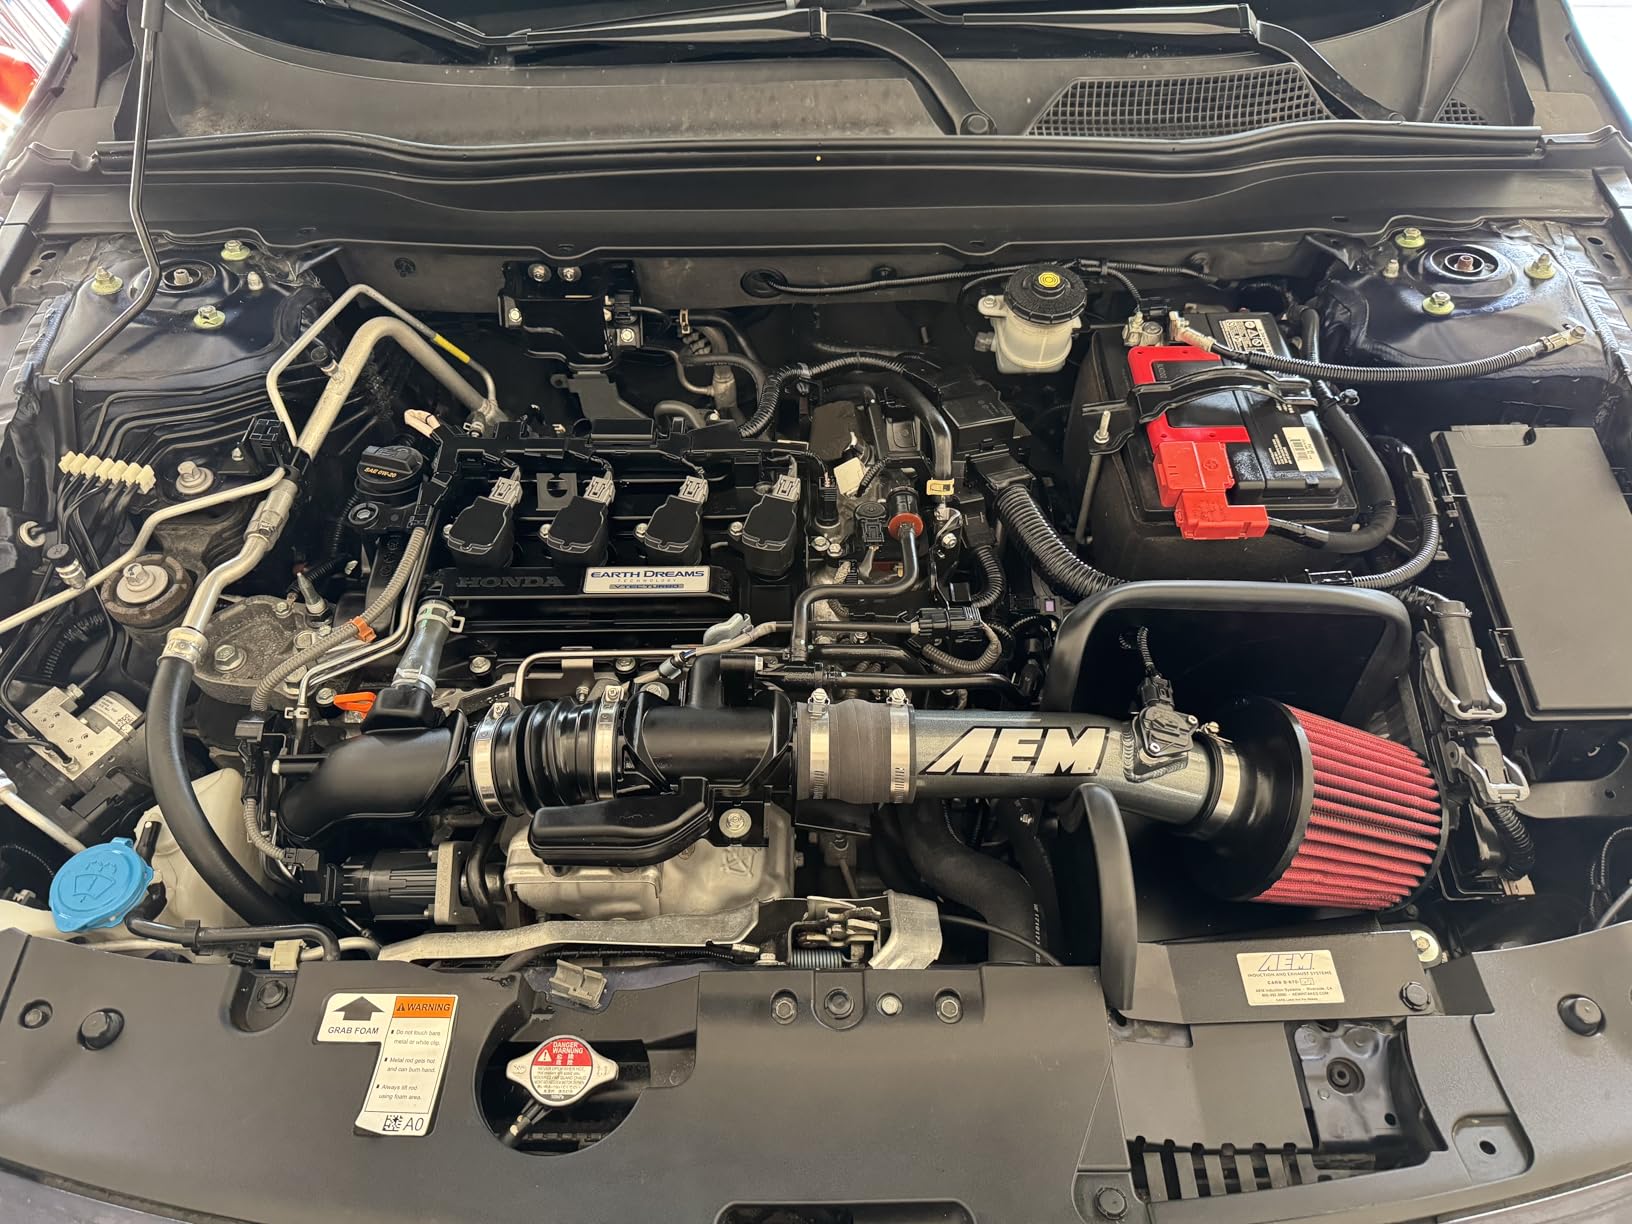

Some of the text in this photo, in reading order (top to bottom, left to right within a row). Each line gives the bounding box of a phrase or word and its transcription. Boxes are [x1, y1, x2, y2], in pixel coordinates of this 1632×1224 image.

[377, 470, 397, 478] 0W-20
[643, 570, 705, 578] DREAMS
[456, 575, 565, 588] HONDA
[918, 726, 1110, 776] AEM
[1258, 953, 1314, 971] AEM
[406, 1003, 451, 1012] WARNING
[327, 1026, 380, 1035] GRAB FOAM
[403, 1117, 424, 1131] A0
